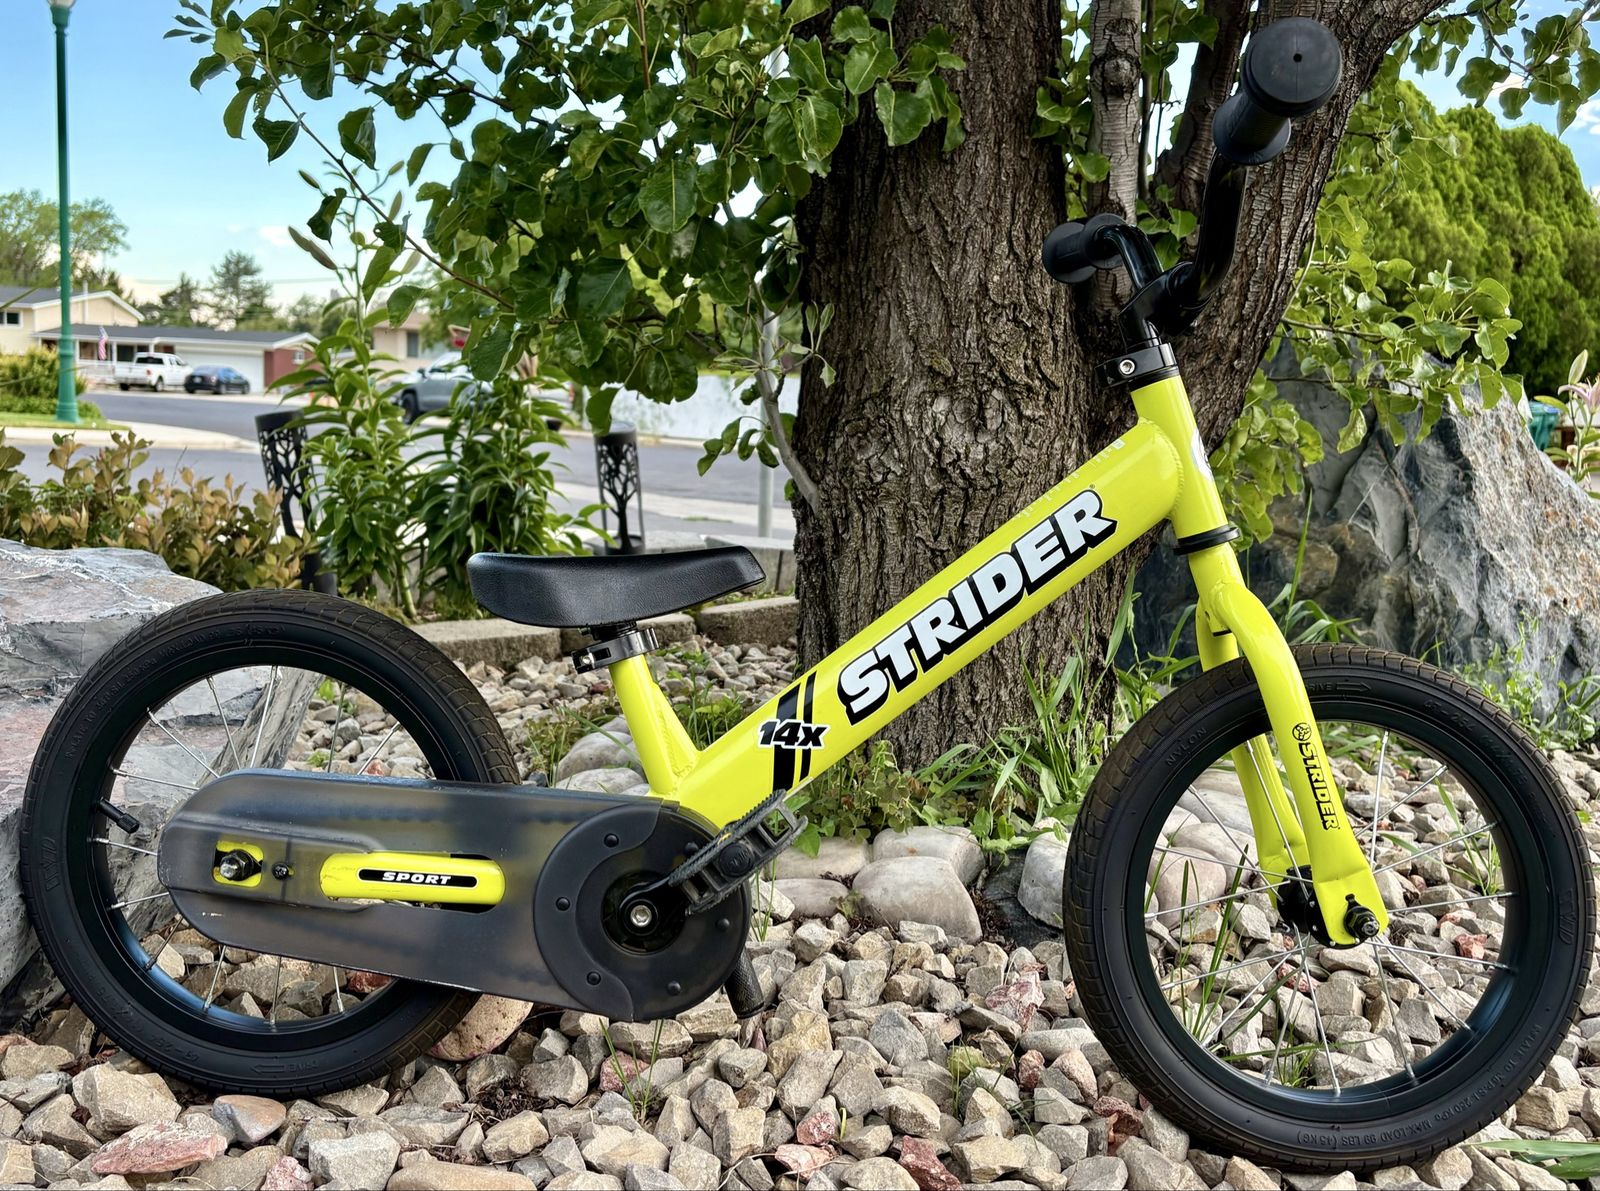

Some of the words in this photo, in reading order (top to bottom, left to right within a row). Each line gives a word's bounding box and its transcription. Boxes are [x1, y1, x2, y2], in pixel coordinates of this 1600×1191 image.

[837, 489, 1118, 726] STRIDER
[1166, 727, 1207, 766] NYLON
[1298, 742, 1339, 830] STRIDER
[382, 871, 451, 885] SPORT
